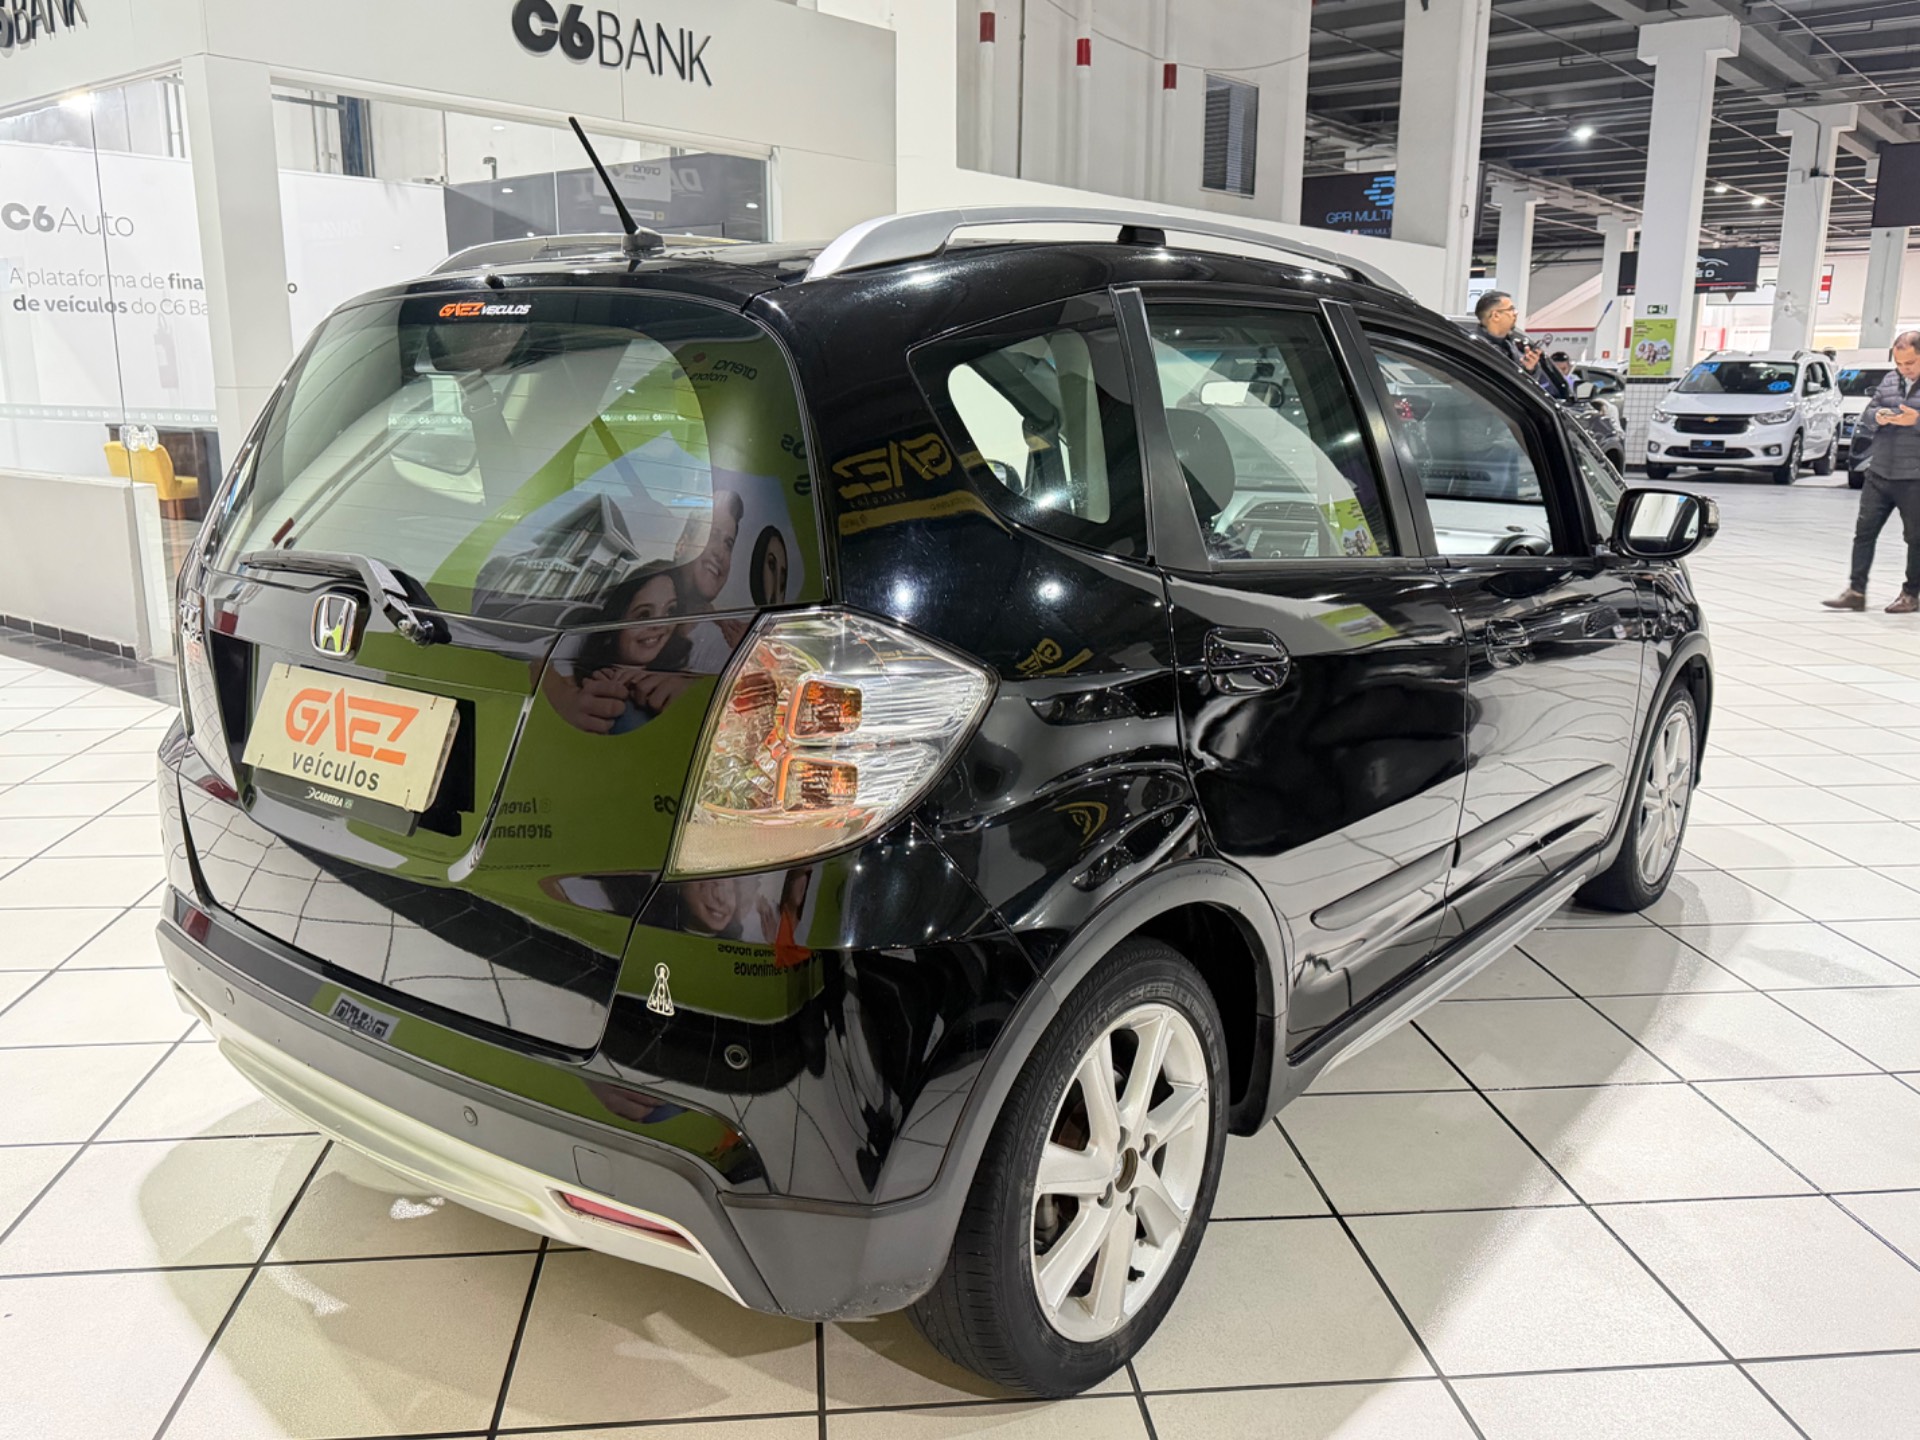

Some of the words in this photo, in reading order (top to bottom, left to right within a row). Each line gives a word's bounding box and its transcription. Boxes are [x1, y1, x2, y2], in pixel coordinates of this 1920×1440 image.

[1326, 211, 1352, 224] GPR
[9, 267, 24, 285] A
[27, 267, 137, 289] plataforma
[140, 272, 165, 290] de
[12, 294, 40, 312] de
[44, 295, 128, 314] veículos
[131, 297, 157, 315] do
[159, 298, 186, 316] C6
[438, 302, 485, 318] GAEZ
[285, 687, 420, 766] GAEZ
[292, 751, 380, 792] veículos
